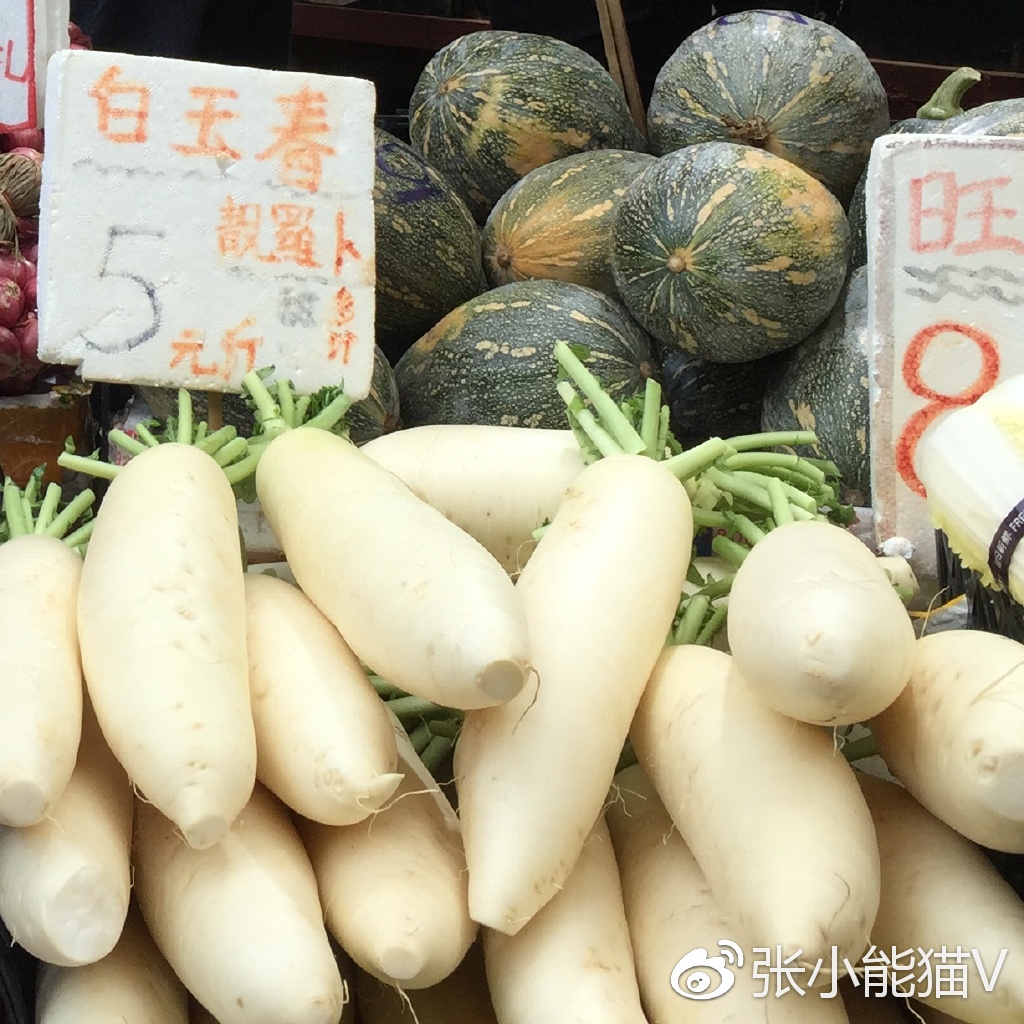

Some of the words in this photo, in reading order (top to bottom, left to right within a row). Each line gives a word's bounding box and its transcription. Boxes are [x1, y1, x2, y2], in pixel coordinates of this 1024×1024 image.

[86, 65, 335, 193] 白玉春
[80, 226, 165, 355] 5
